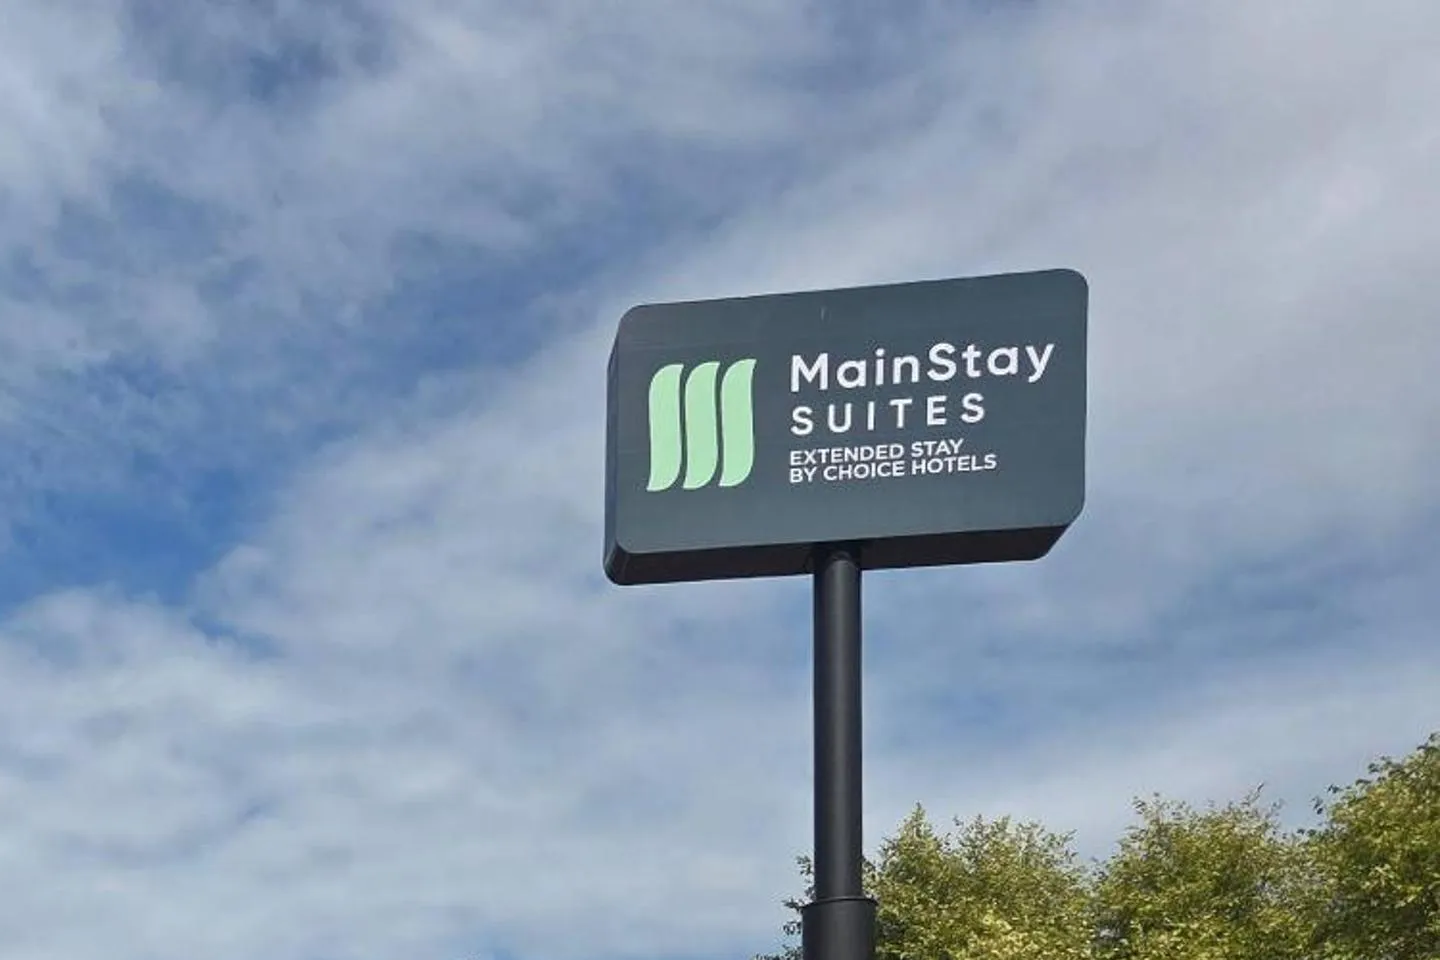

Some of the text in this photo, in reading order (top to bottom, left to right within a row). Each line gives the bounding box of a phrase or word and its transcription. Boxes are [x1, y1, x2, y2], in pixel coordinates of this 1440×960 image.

[790, 342, 1055, 393] MainStay
[790, 393, 986, 436] SUITES
[789, 438, 964, 466] EXTENDED STAY
[789, 453, 998, 484] BY CHOICE HOTELS
